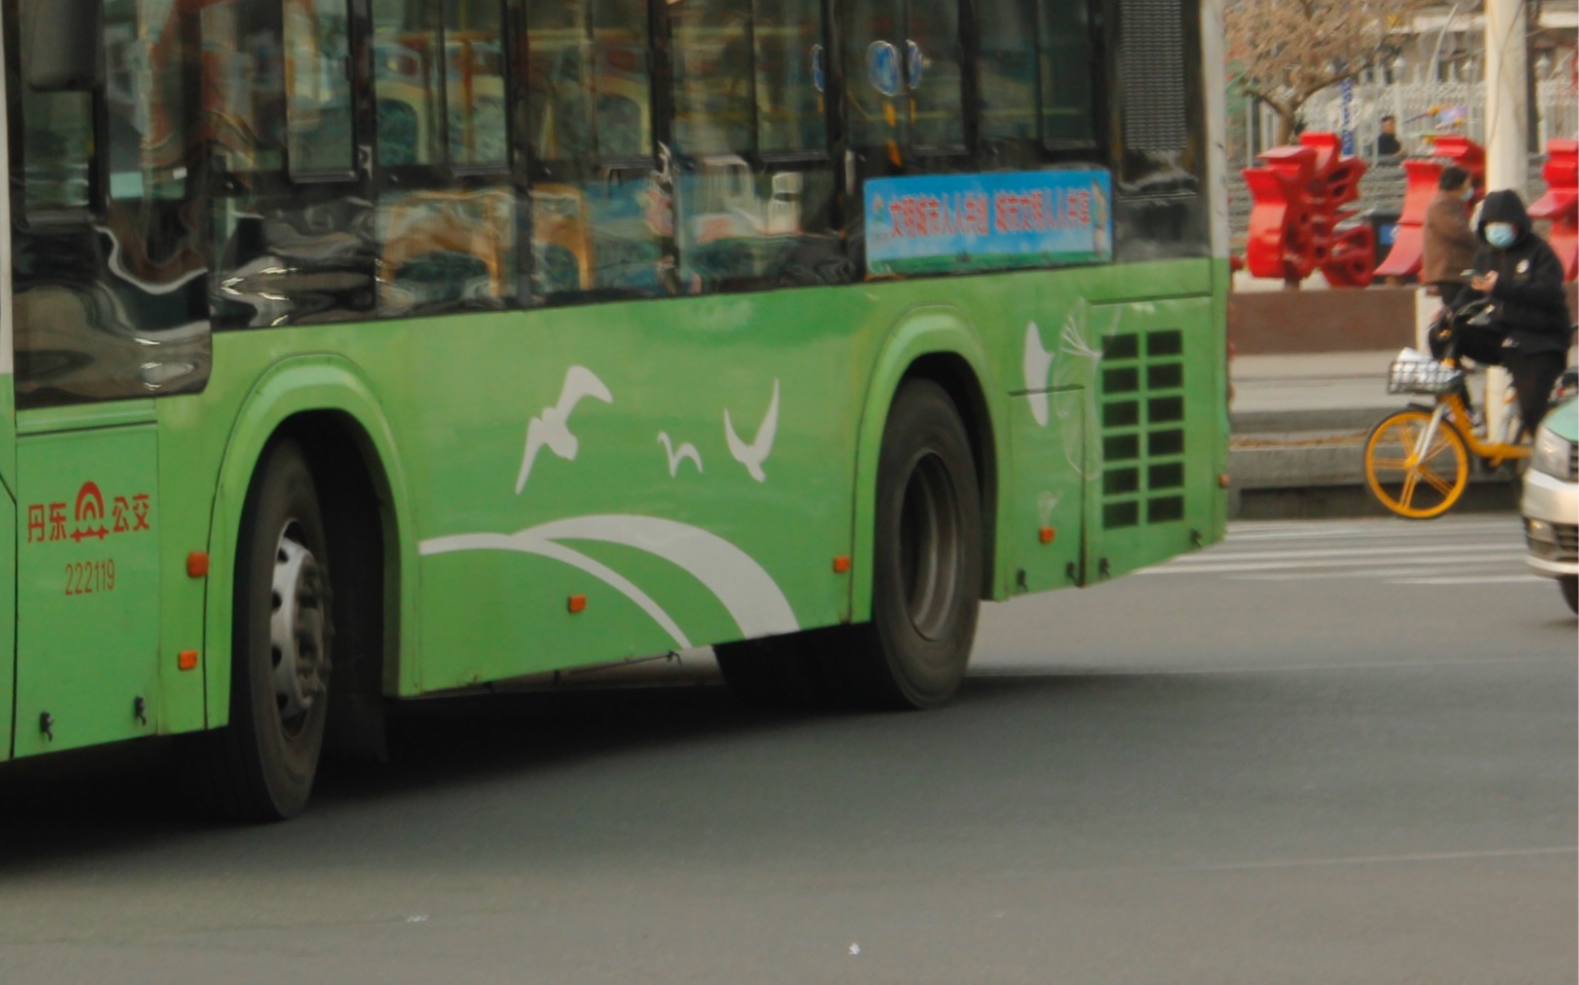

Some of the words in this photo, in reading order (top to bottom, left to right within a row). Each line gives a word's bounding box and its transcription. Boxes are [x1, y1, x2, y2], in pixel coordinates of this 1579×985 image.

[27, 503, 67, 544] 丹东
[111, 492, 150, 532] 公交
[65, 558, 115, 595] 222119
